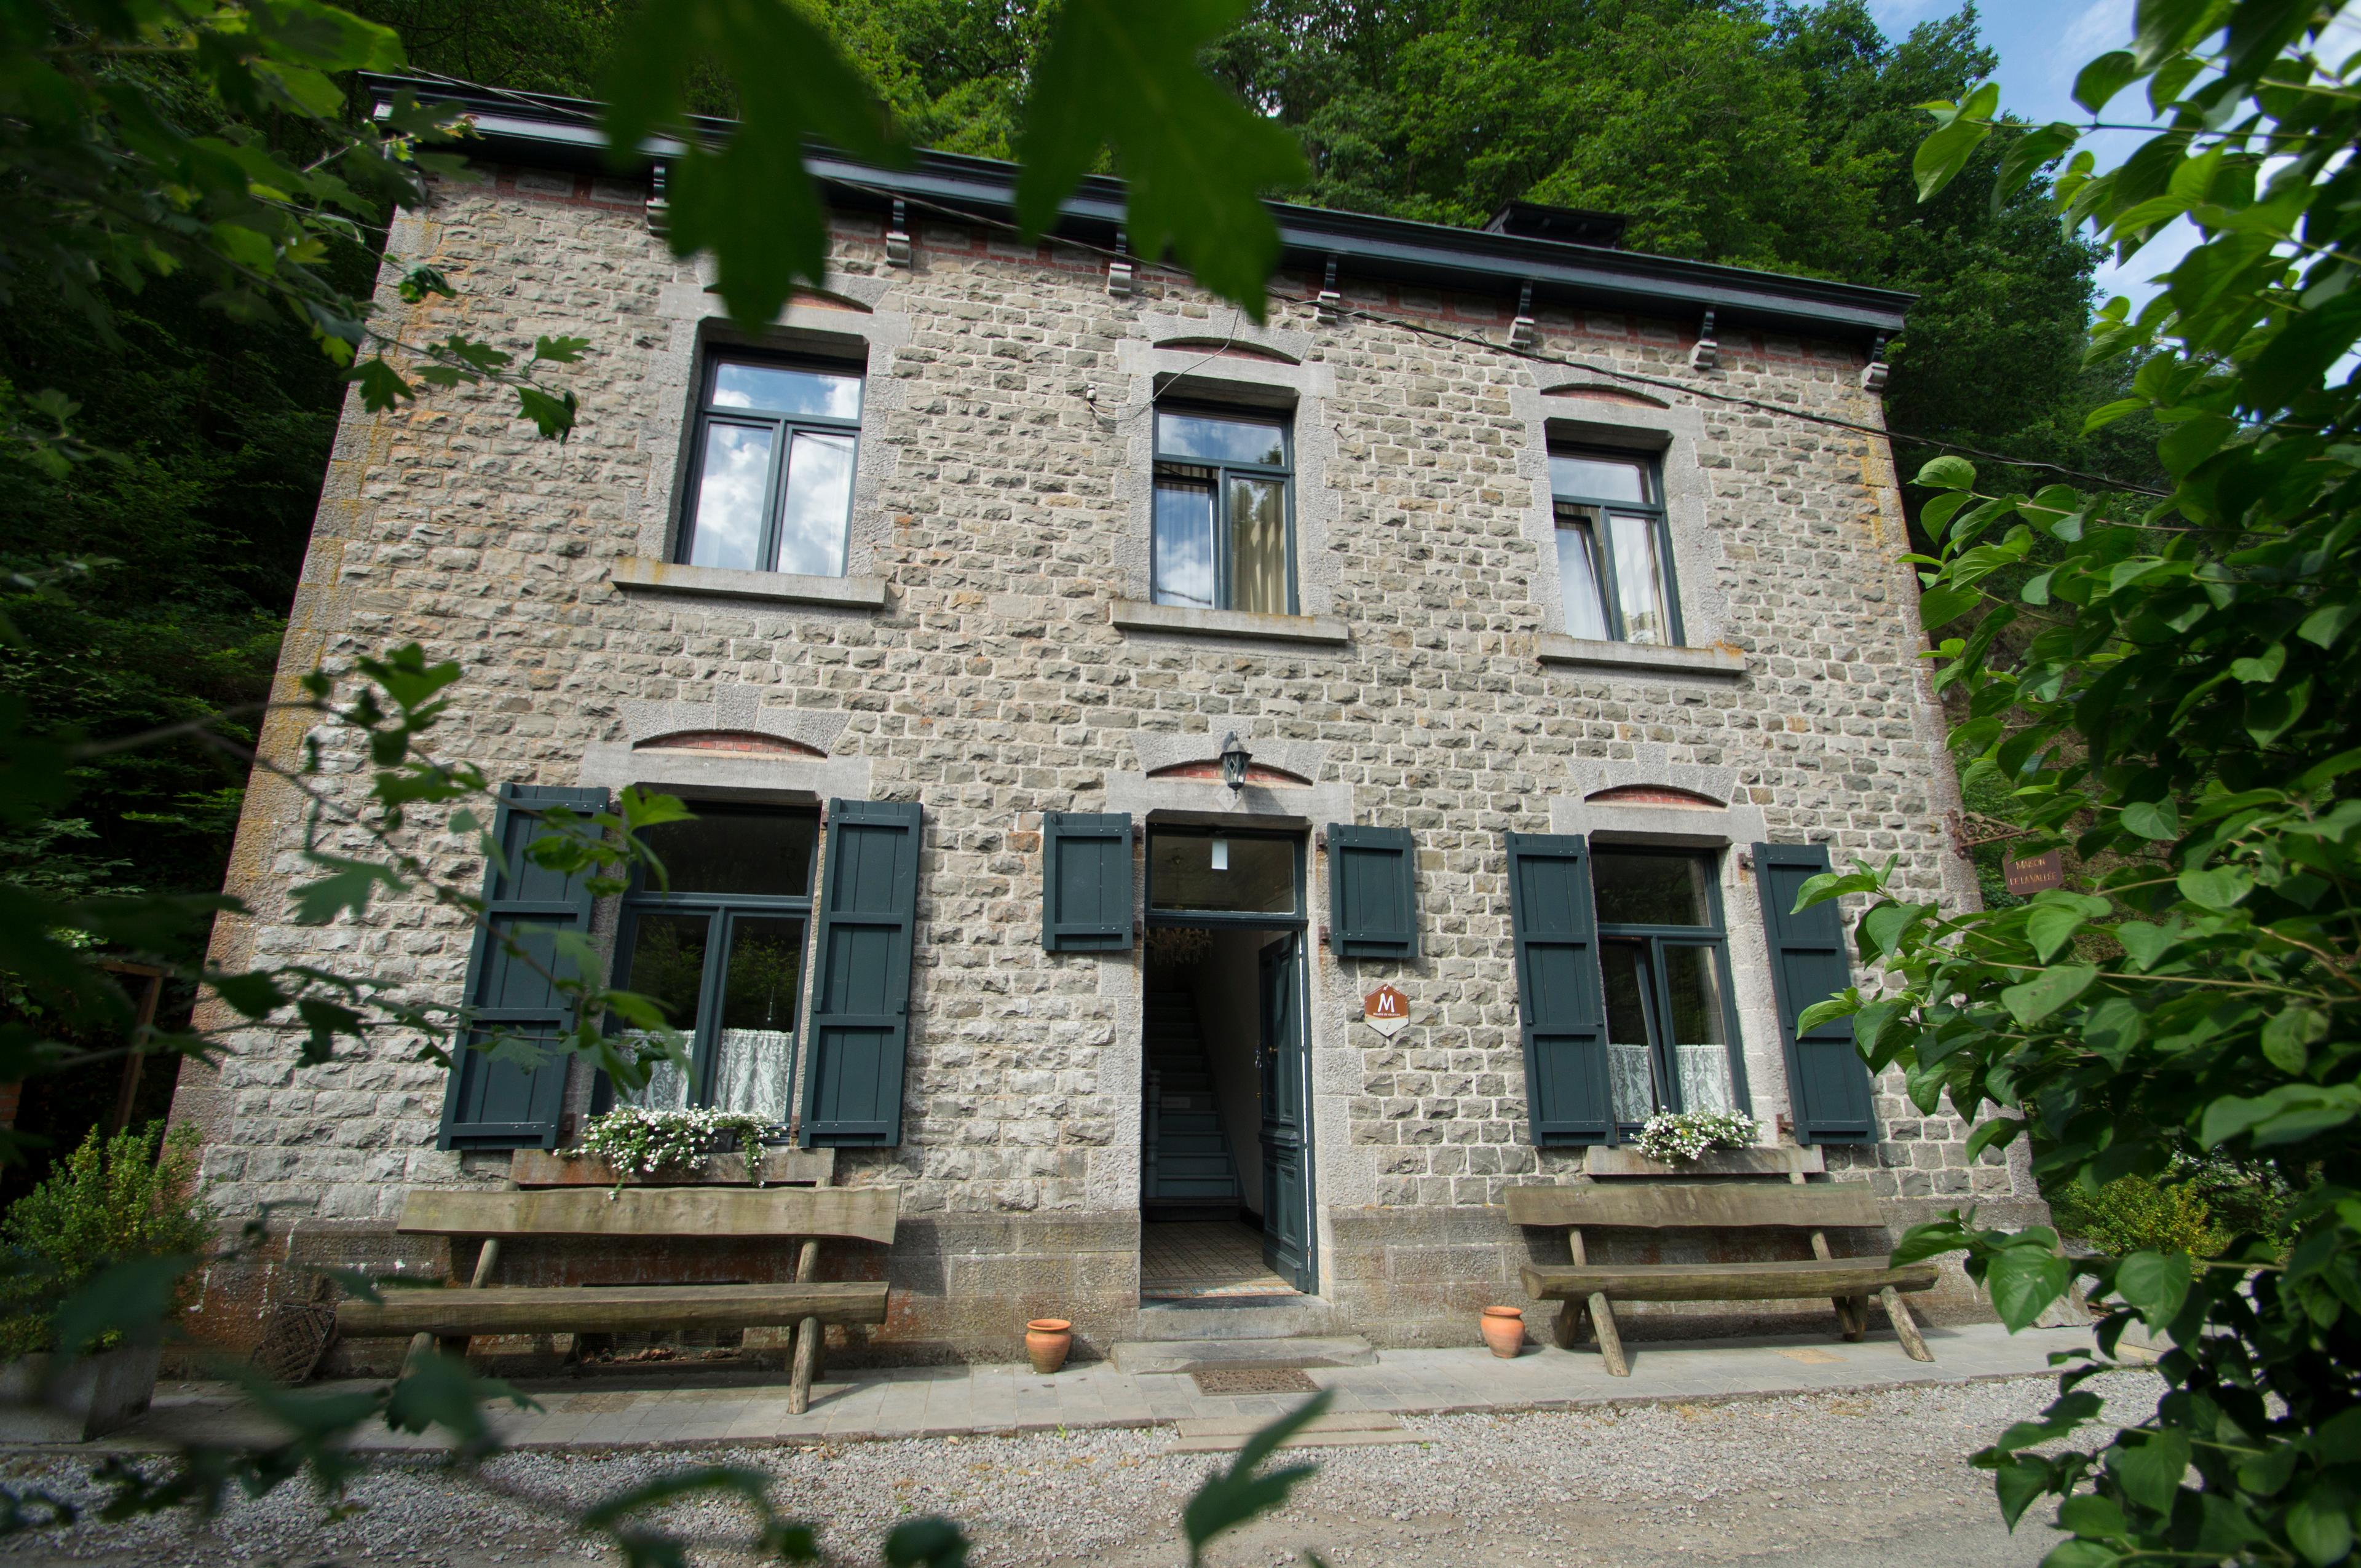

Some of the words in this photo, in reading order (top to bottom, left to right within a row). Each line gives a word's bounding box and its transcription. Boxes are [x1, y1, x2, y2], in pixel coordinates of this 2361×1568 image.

[2016, 858, 2046, 870] MAISON
[2020, 875, 2030, 884] LA
[1377, 993, 1394, 1012] M
